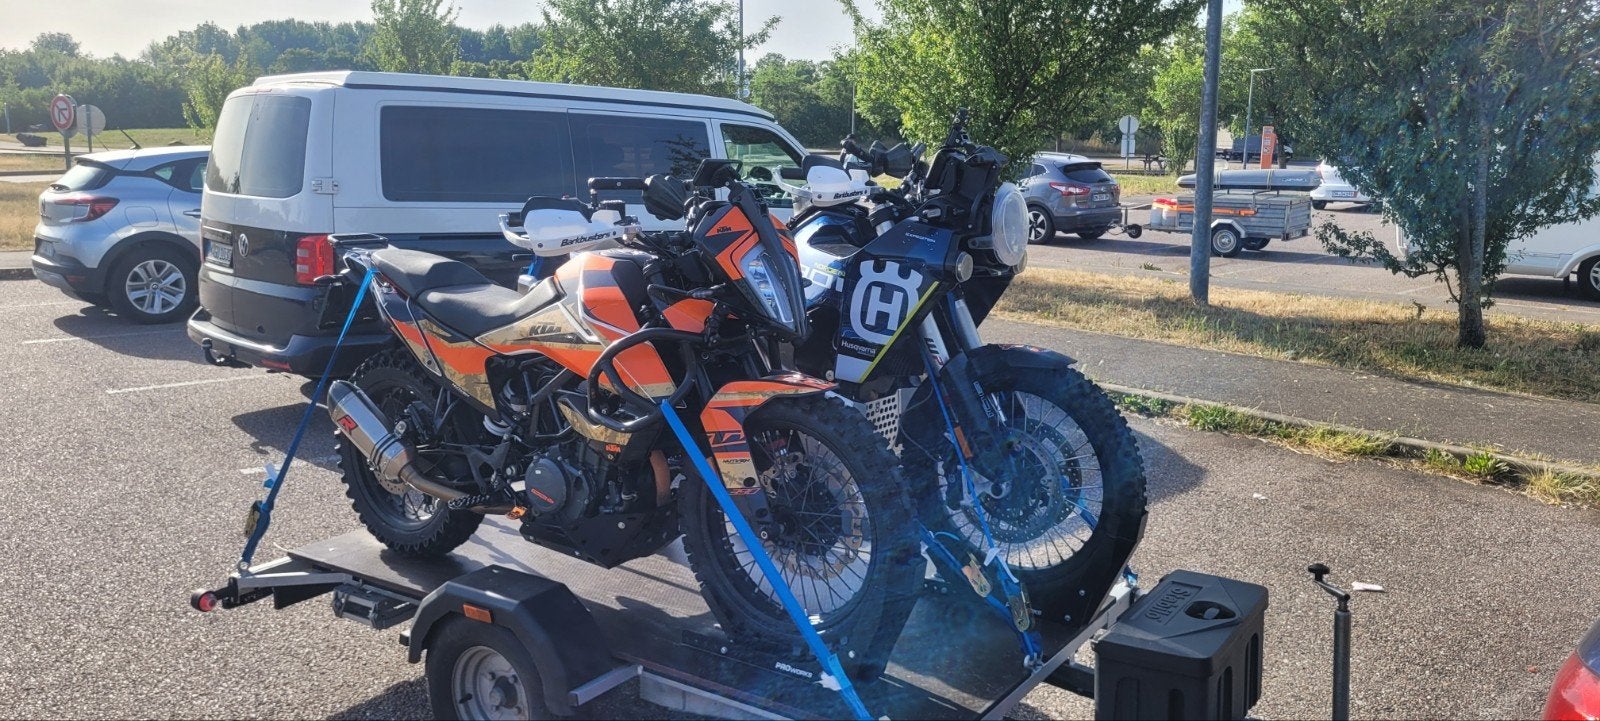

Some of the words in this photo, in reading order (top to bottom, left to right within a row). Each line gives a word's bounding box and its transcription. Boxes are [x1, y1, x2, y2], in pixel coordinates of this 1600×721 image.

[716, 226, 732, 234] KTM
[560, 231, 611, 247] Barkbusters
[529, 324, 562, 336] KTM
[841, 340, 877, 355] Husqvarna
